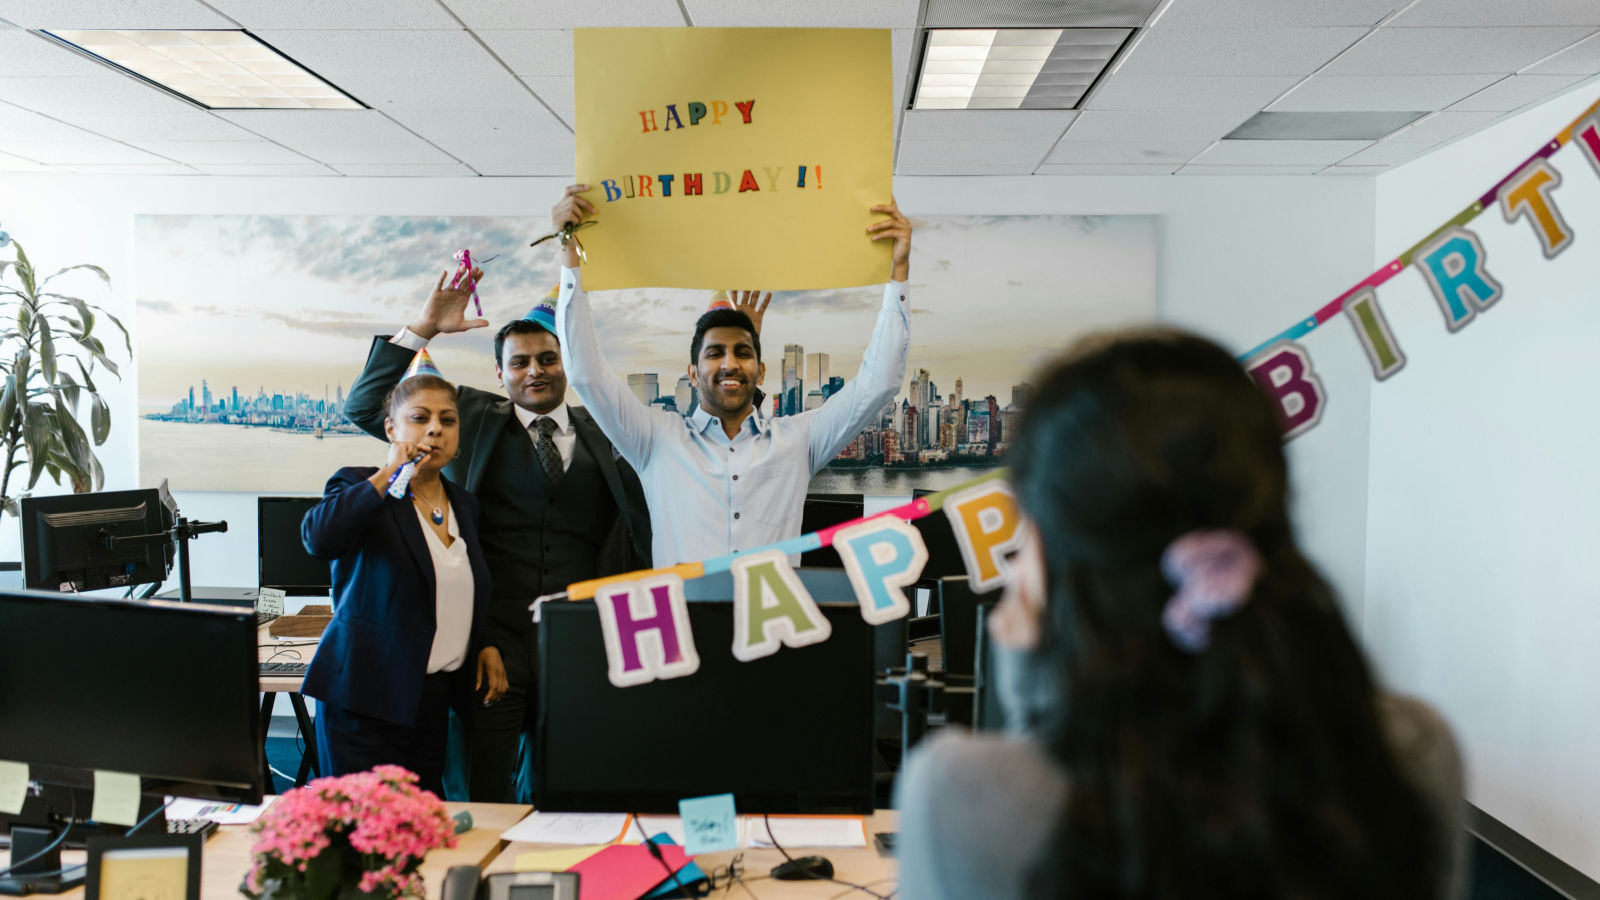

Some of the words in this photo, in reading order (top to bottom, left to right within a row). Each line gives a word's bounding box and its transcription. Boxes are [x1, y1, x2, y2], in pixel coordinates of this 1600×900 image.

[638, 99, 756, 134] HAPPY
[1246, 118, 1600, 438] BIRT
[606, 488, 1021, 677] HAPP
